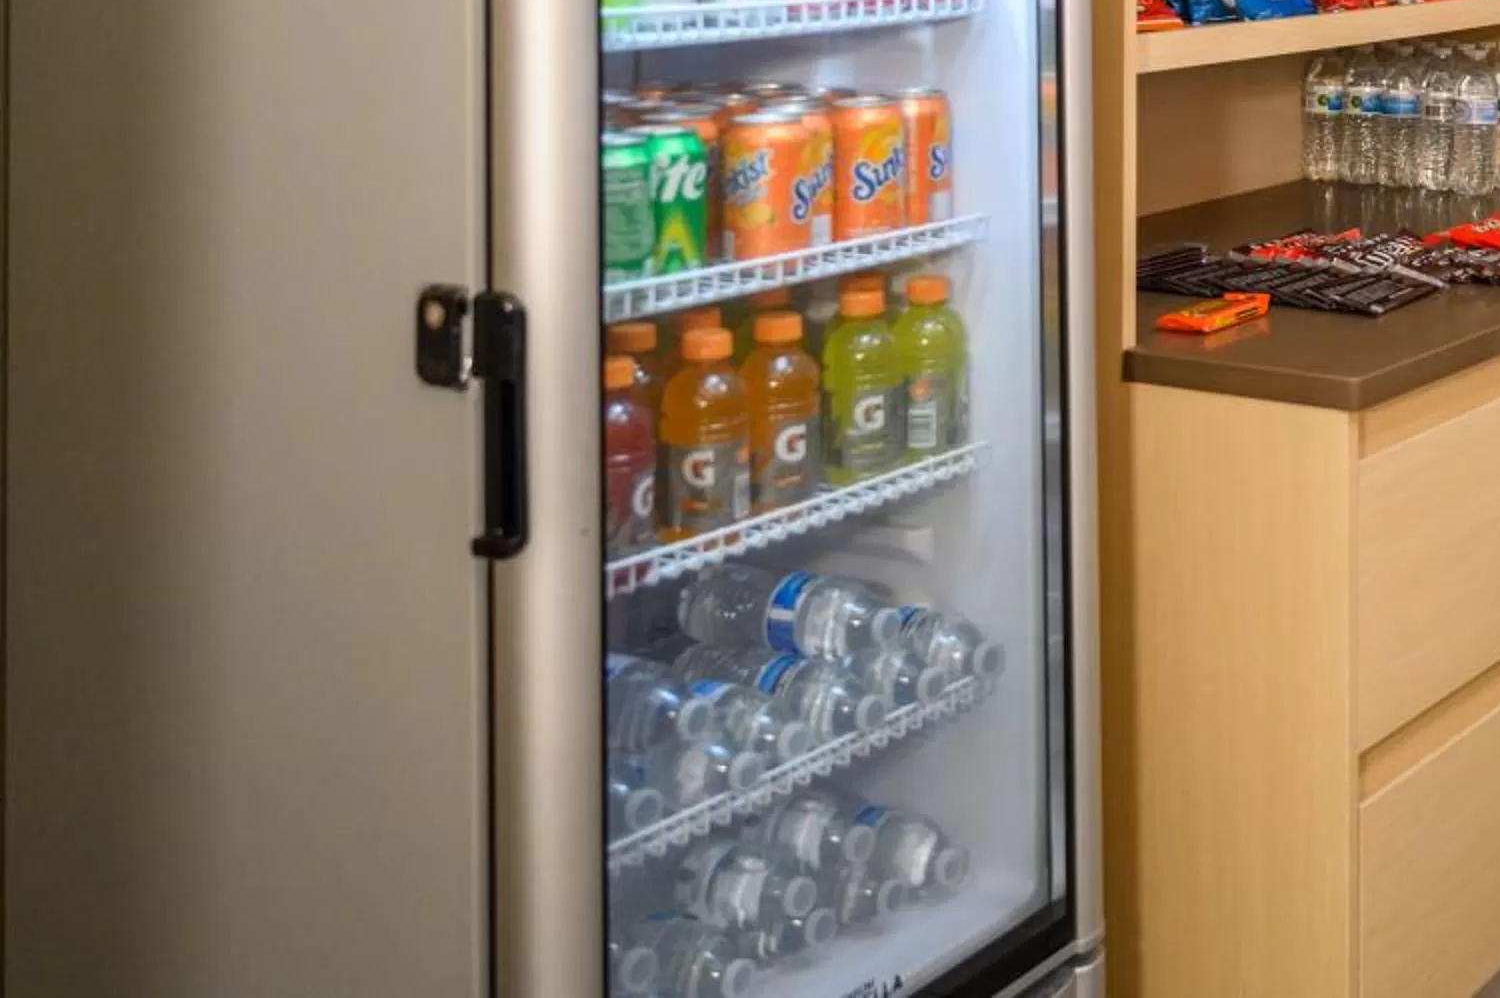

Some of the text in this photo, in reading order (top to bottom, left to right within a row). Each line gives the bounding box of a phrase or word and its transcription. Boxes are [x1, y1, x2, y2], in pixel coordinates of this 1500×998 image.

[854, 395, 886, 431] G
[774, 424, 807, 462] G
[682, 450, 715, 487] G
